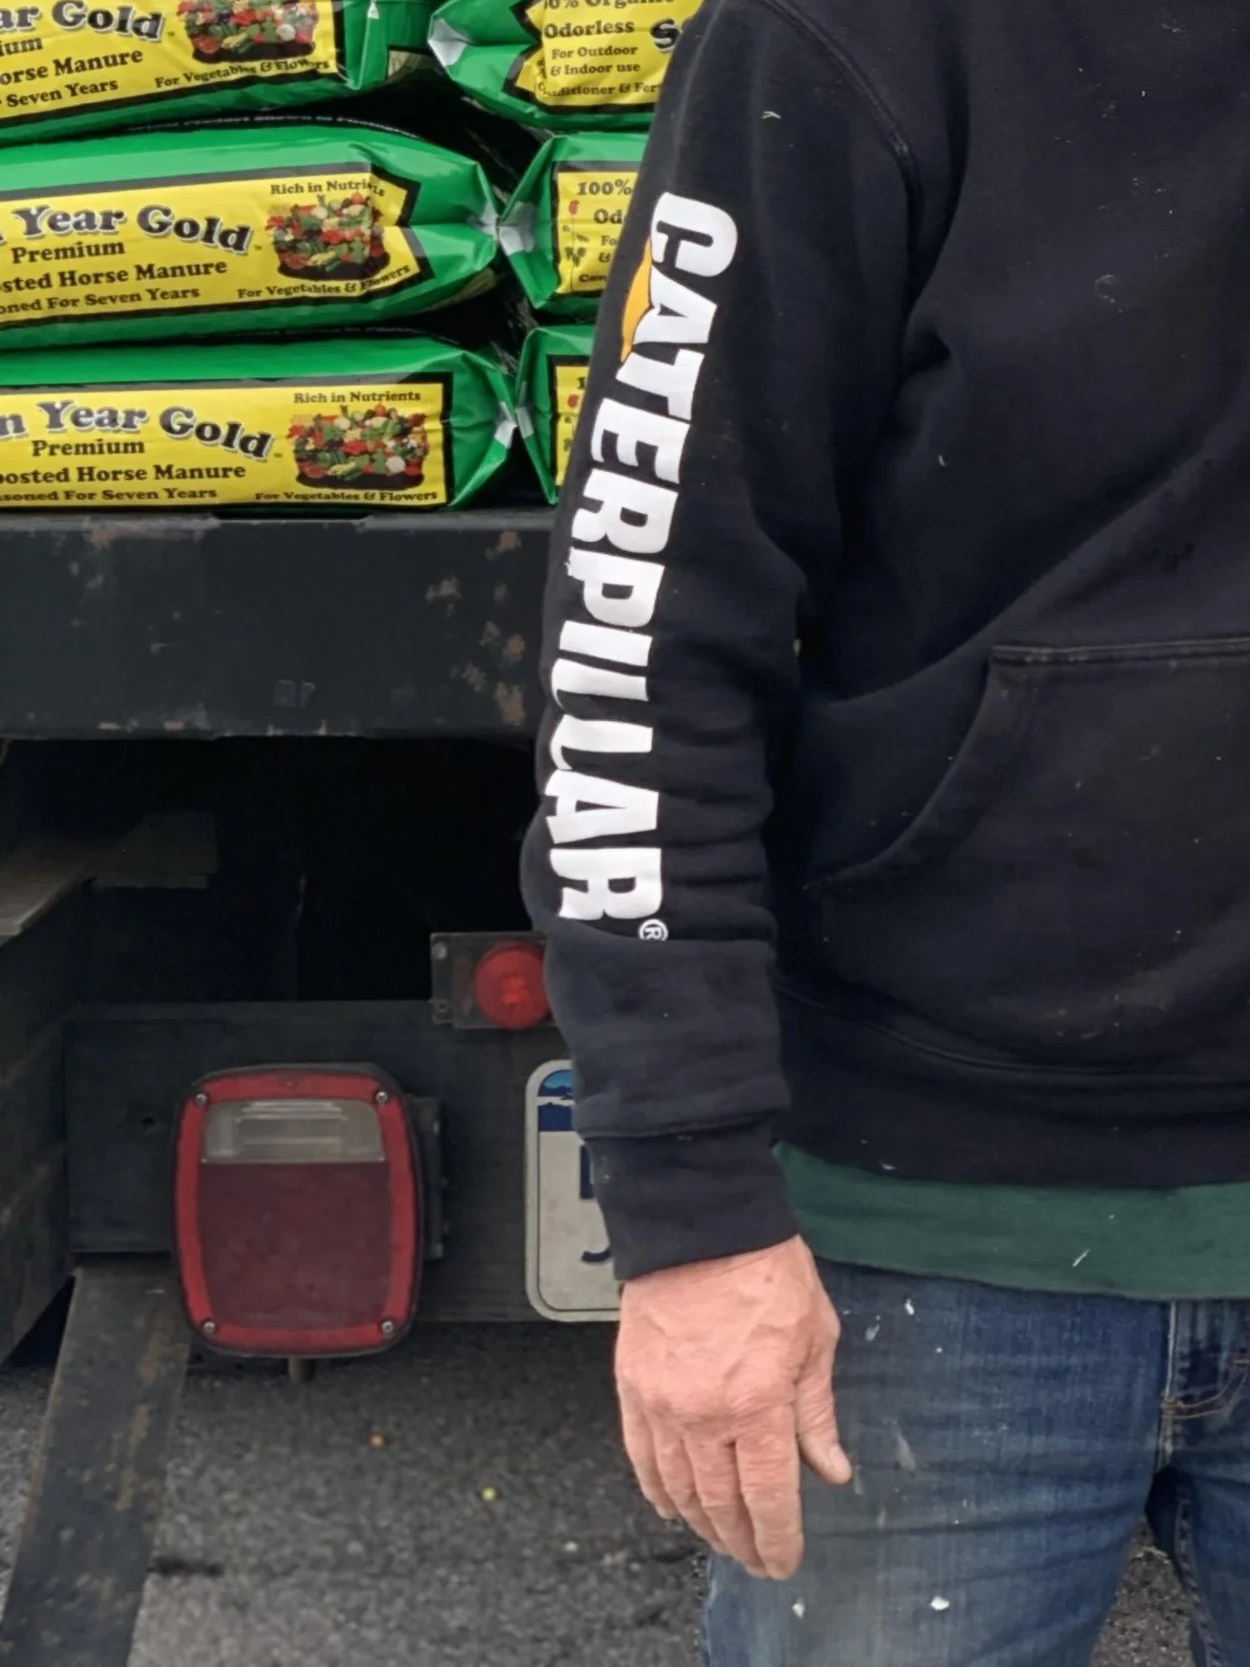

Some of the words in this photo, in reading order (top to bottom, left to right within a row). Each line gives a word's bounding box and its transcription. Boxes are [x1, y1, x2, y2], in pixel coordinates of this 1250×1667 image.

[544, 20, 635, 38] Odorless
[552, 49, 572, 59] For
[577, 46, 638, 57] Outdoor
[53, 50, 143, 76] Manure
[564, 65, 613, 75] Indoor
[7, 90, 62, 108] Seven
[65, 80, 119, 98] Years
[271, 184, 304, 195] Rich
[577, 179, 632, 196] 100%
[12, 205, 127, 240] Year
[137, 204, 254, 256] Gold
[12, 241, 124, 264] Premium
[57, 270, 128, 287] Horse
[134, 261, 227, 281] Manure
[47, 297, 79, 309] For
[85, 292, 141, 306] Seven
[146, 288, 200, 301] Years
[267, 285, 340, 297] Vegetables
[294, 393, 327, 403] Rich
[332, 392, 345, 402] in
[350, 391, 421, 402] Nutrients
[36, 400, 150, 434] Year
[159, 405, 276, 462] Gold
[31, 439, 145, 456] Premium
[76, 466, 147, 482] Horse
[153, 464, 246, 480] Manure
[63, 490, 96, 501] For
[102, 489, 159, 500] Seven
[164, 488, 217, 498] Years
[284, 492, 360, 501] Vegetables
[380, 491, 438, 502] Flowers
[543, 190, 738, 923] CATERPILLAR
